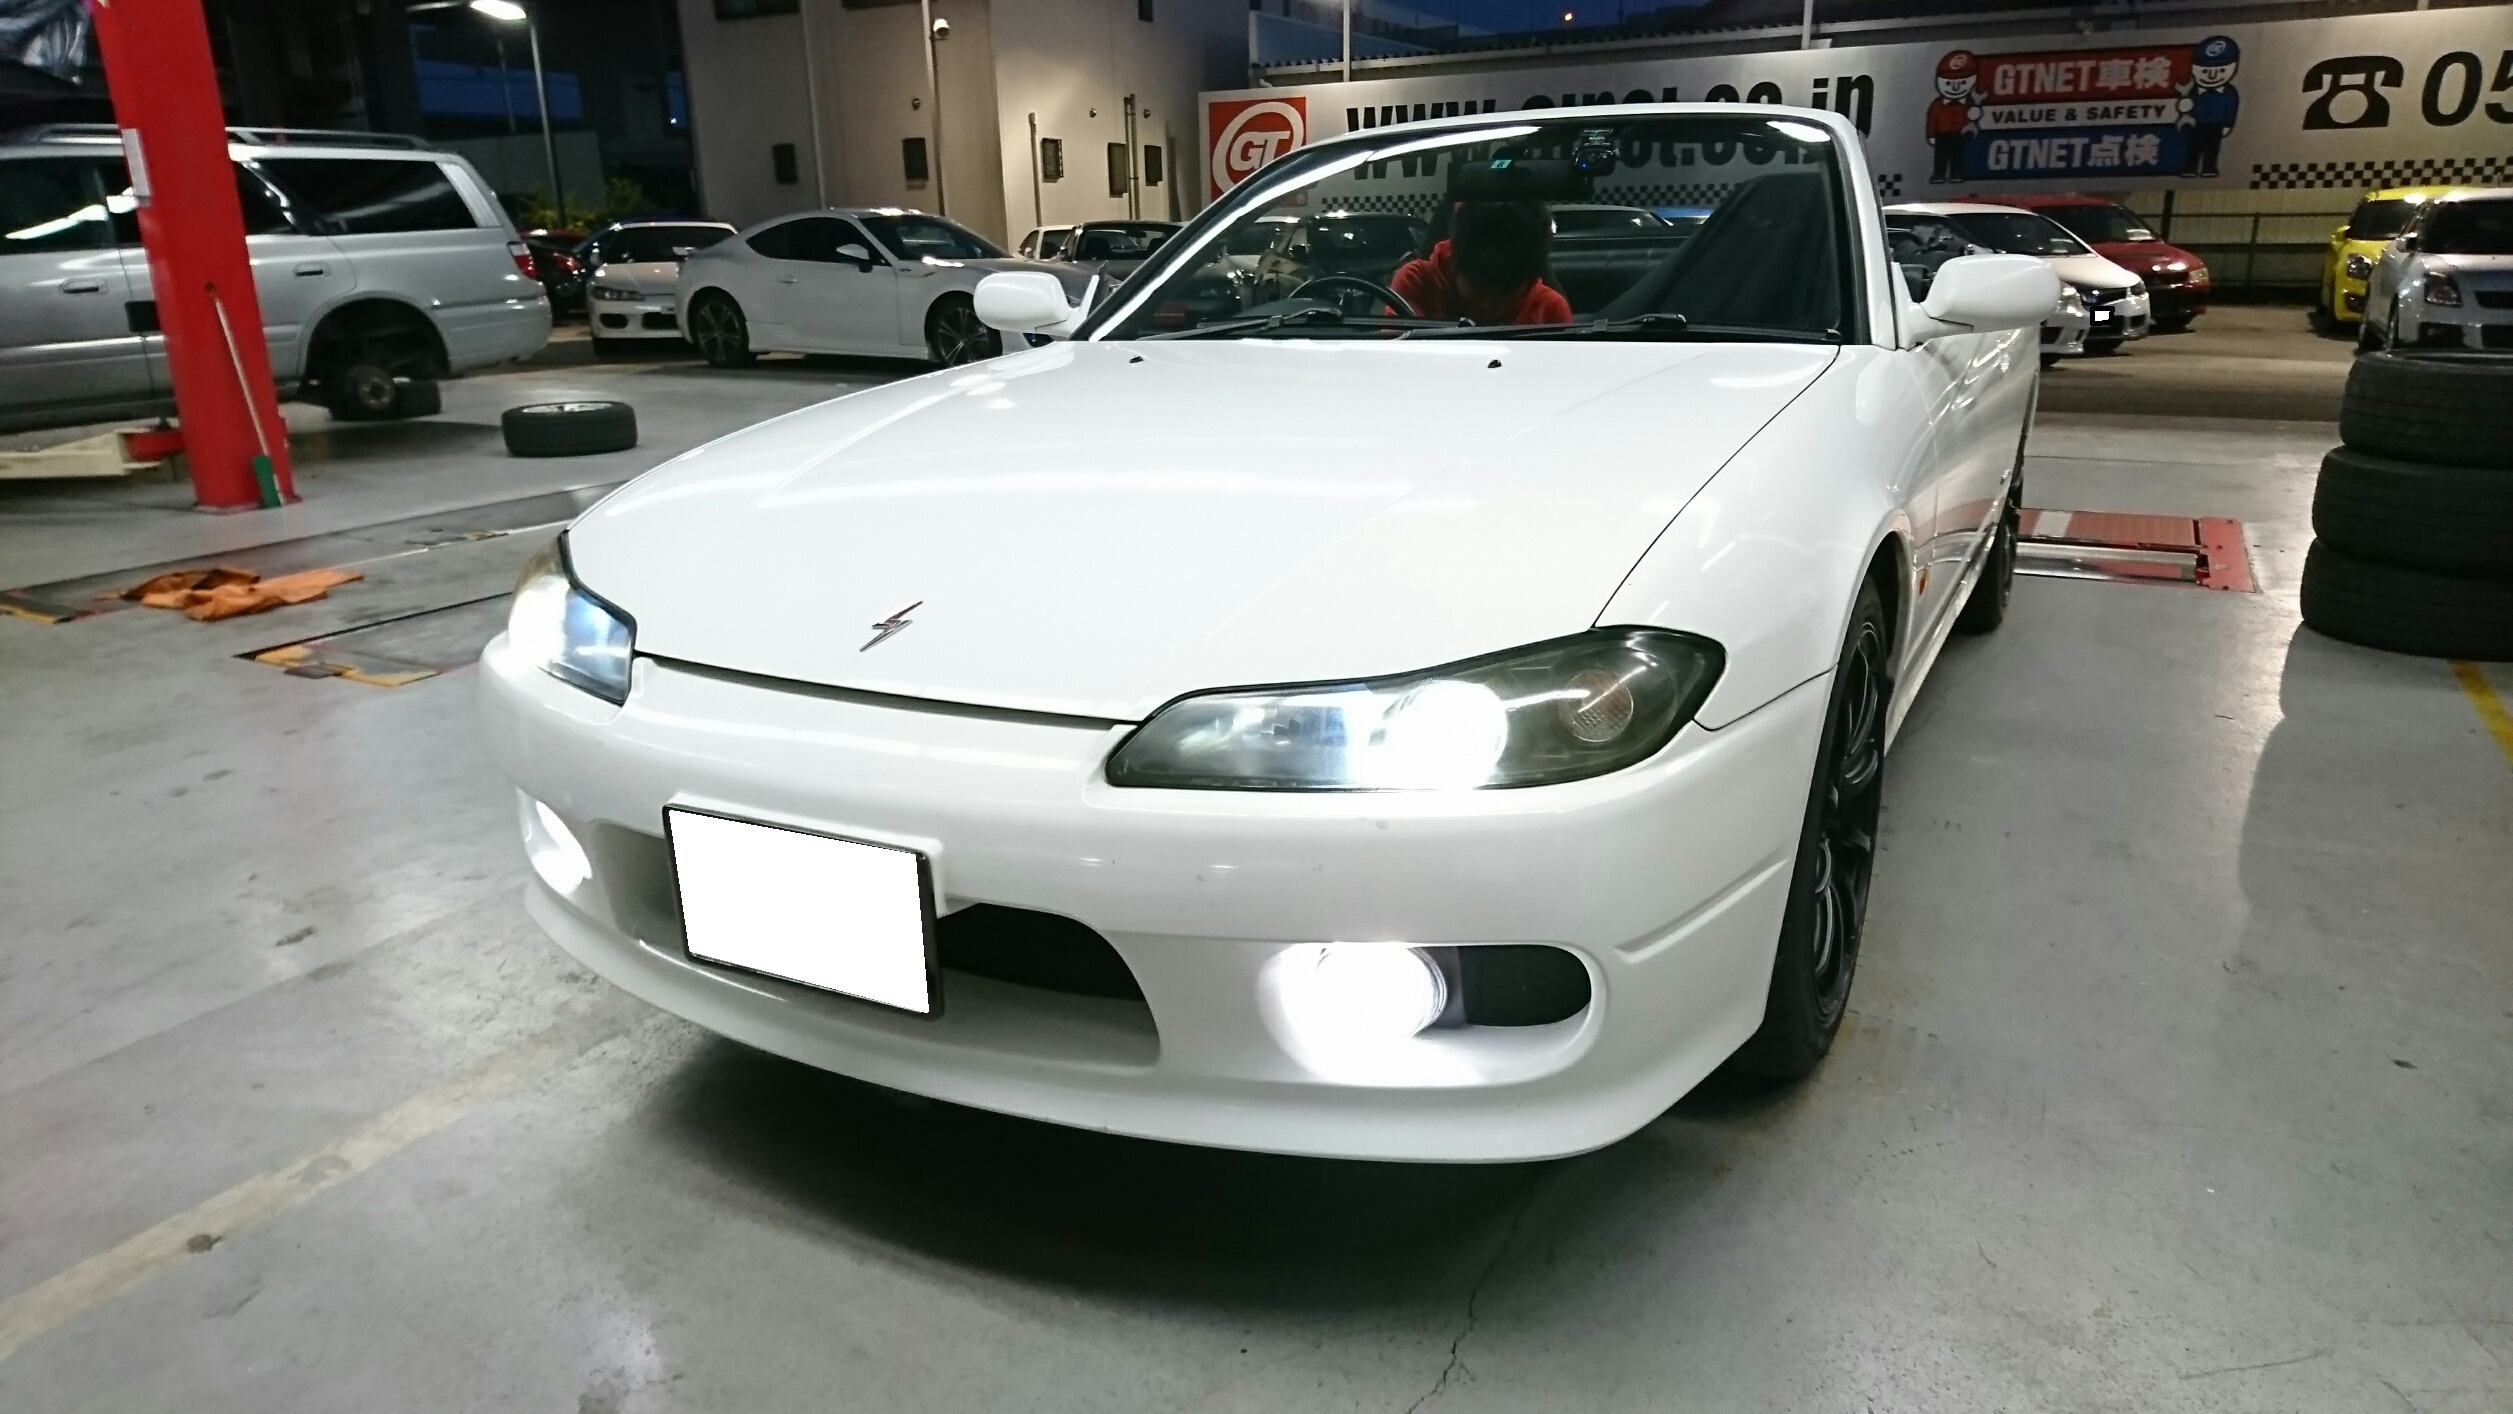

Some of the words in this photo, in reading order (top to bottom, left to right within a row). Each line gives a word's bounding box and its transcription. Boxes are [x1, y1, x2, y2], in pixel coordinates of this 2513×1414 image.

[1993, 56, 2172, 95] GTNET車検
[1992, 107, 2056, 124] VALUE
[2064, 107, 2078, 121] &
[2086, 103, 2166, 121] SAFETY
[1229, 129, 1291, 172] GT
[1987, 134, 2161, 171] GTNET点検
